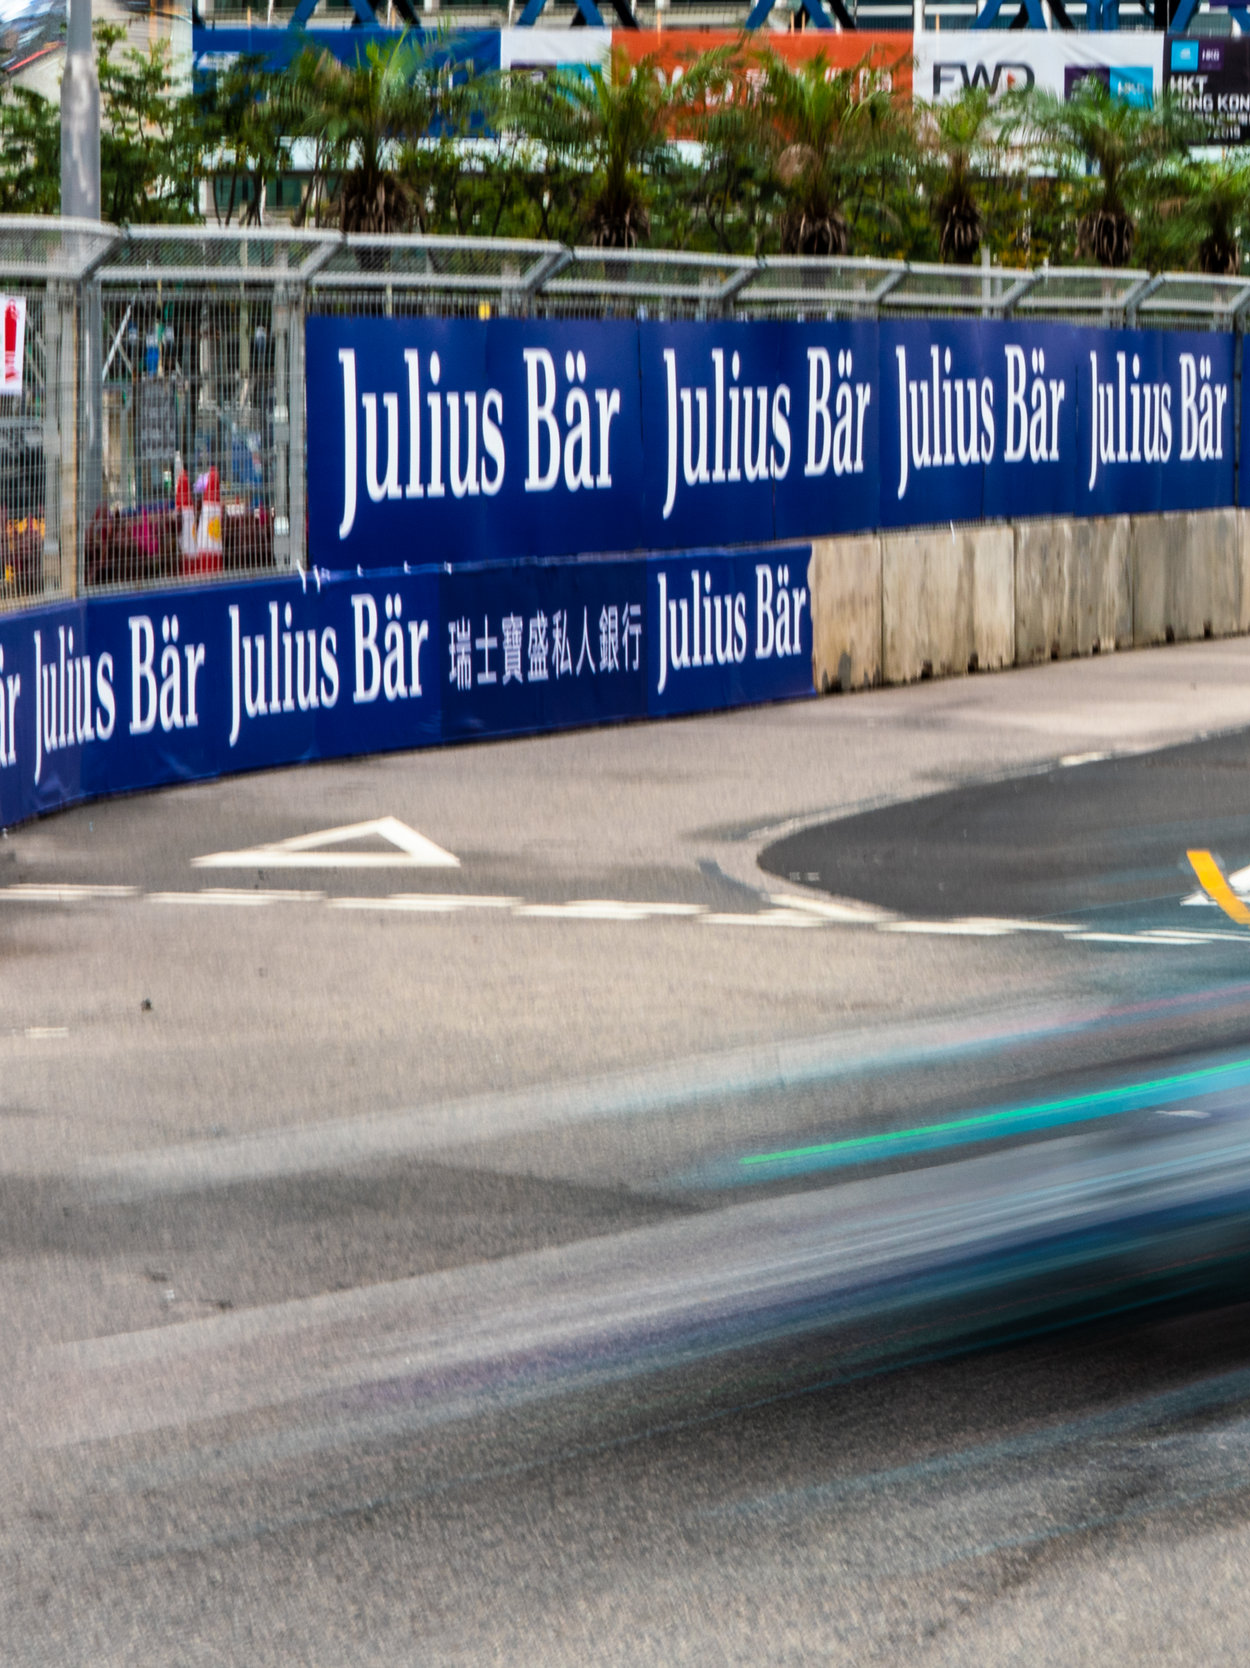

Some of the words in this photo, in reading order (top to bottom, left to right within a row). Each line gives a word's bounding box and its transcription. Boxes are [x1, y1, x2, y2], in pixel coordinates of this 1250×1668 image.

[933, 60, 1035, 98] FWD
[339, 348, 505, 539] Julius
[524, 348, 620, 492] Bär
[663, 348, 791, 519] Julius
[805, 347, 871, 476] Bär
[896, 346, 995, 499] Julius
[1004, 345, 1065, 462] Bär
[1089, 351, 1172, 491] Julius
[1179, 353, 1227, 462] Bär
[34, 625, 116, 786] Julius
[129, 614, 205, 734] Bär
[229, 601, 339, 747] Julius
[351, 593, 429, 703] Bär
[448, 601, 642, 690] 瑞士寶盛私人銀行
[658, 571, 747, 694] Julius
[755, 565, 807, 658] Bär
